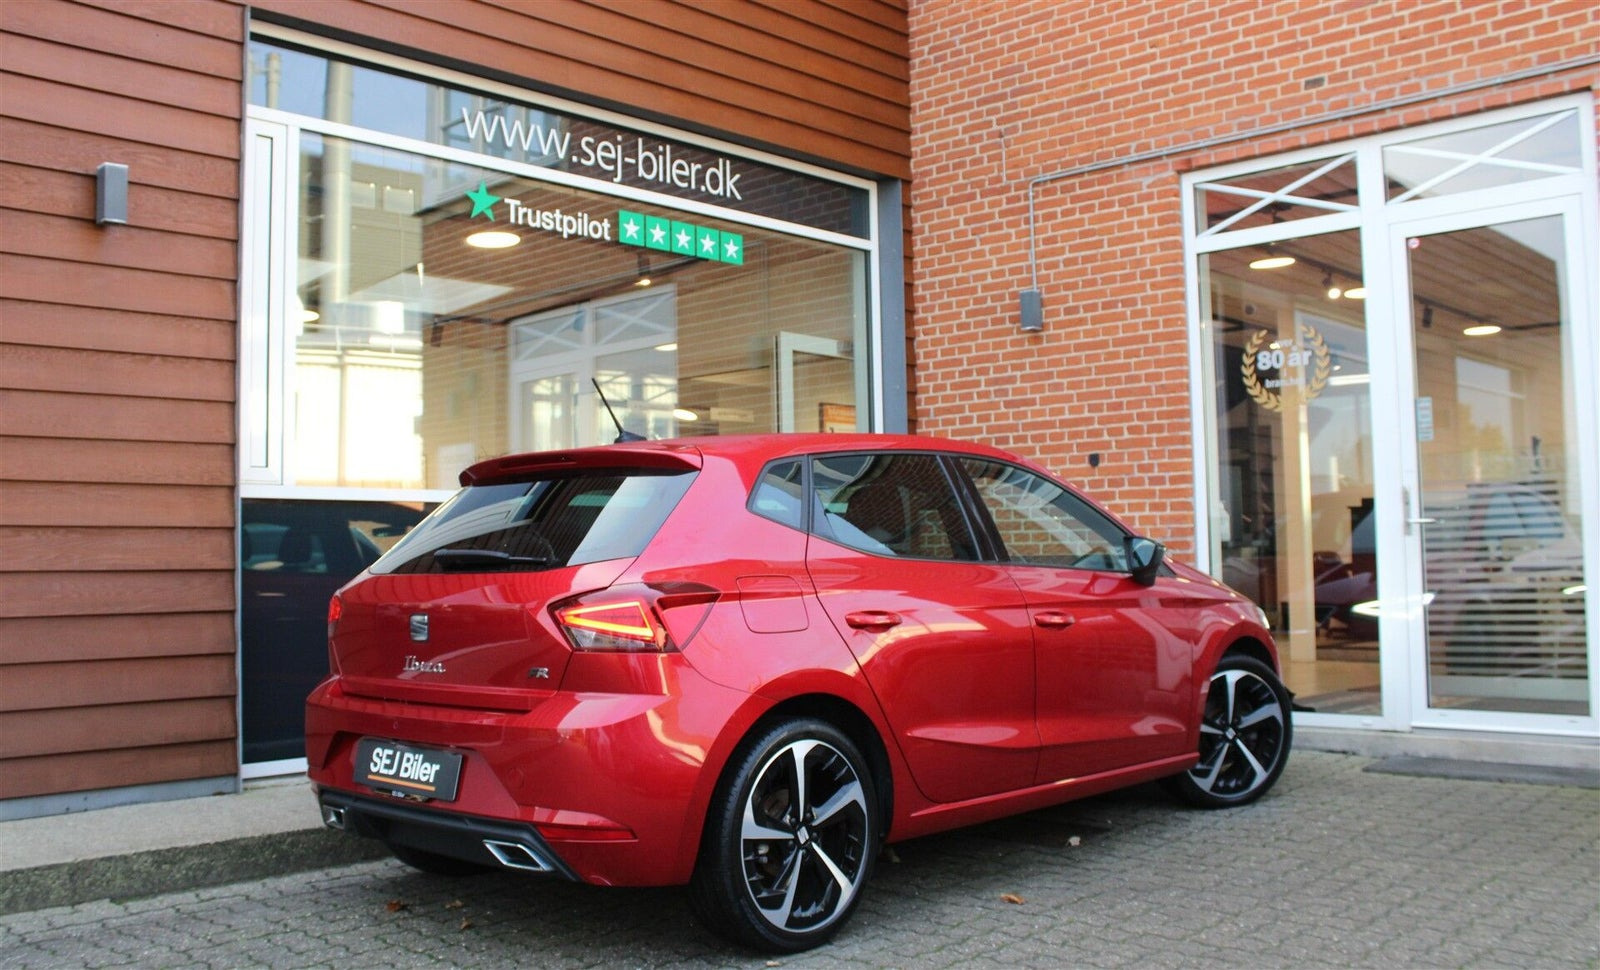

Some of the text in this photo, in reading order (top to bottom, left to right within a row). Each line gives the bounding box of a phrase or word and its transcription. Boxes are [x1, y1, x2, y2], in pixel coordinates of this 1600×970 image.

[462, 107, 742, 199] www.sej-biler.dk
[504, 198, 611, 241] Trustpilot
[1257, 345, 1312, 370] 80 år
[403, 655, 446, 673] Ibiza
[369, 747, 440, 782] SEJ Biler
